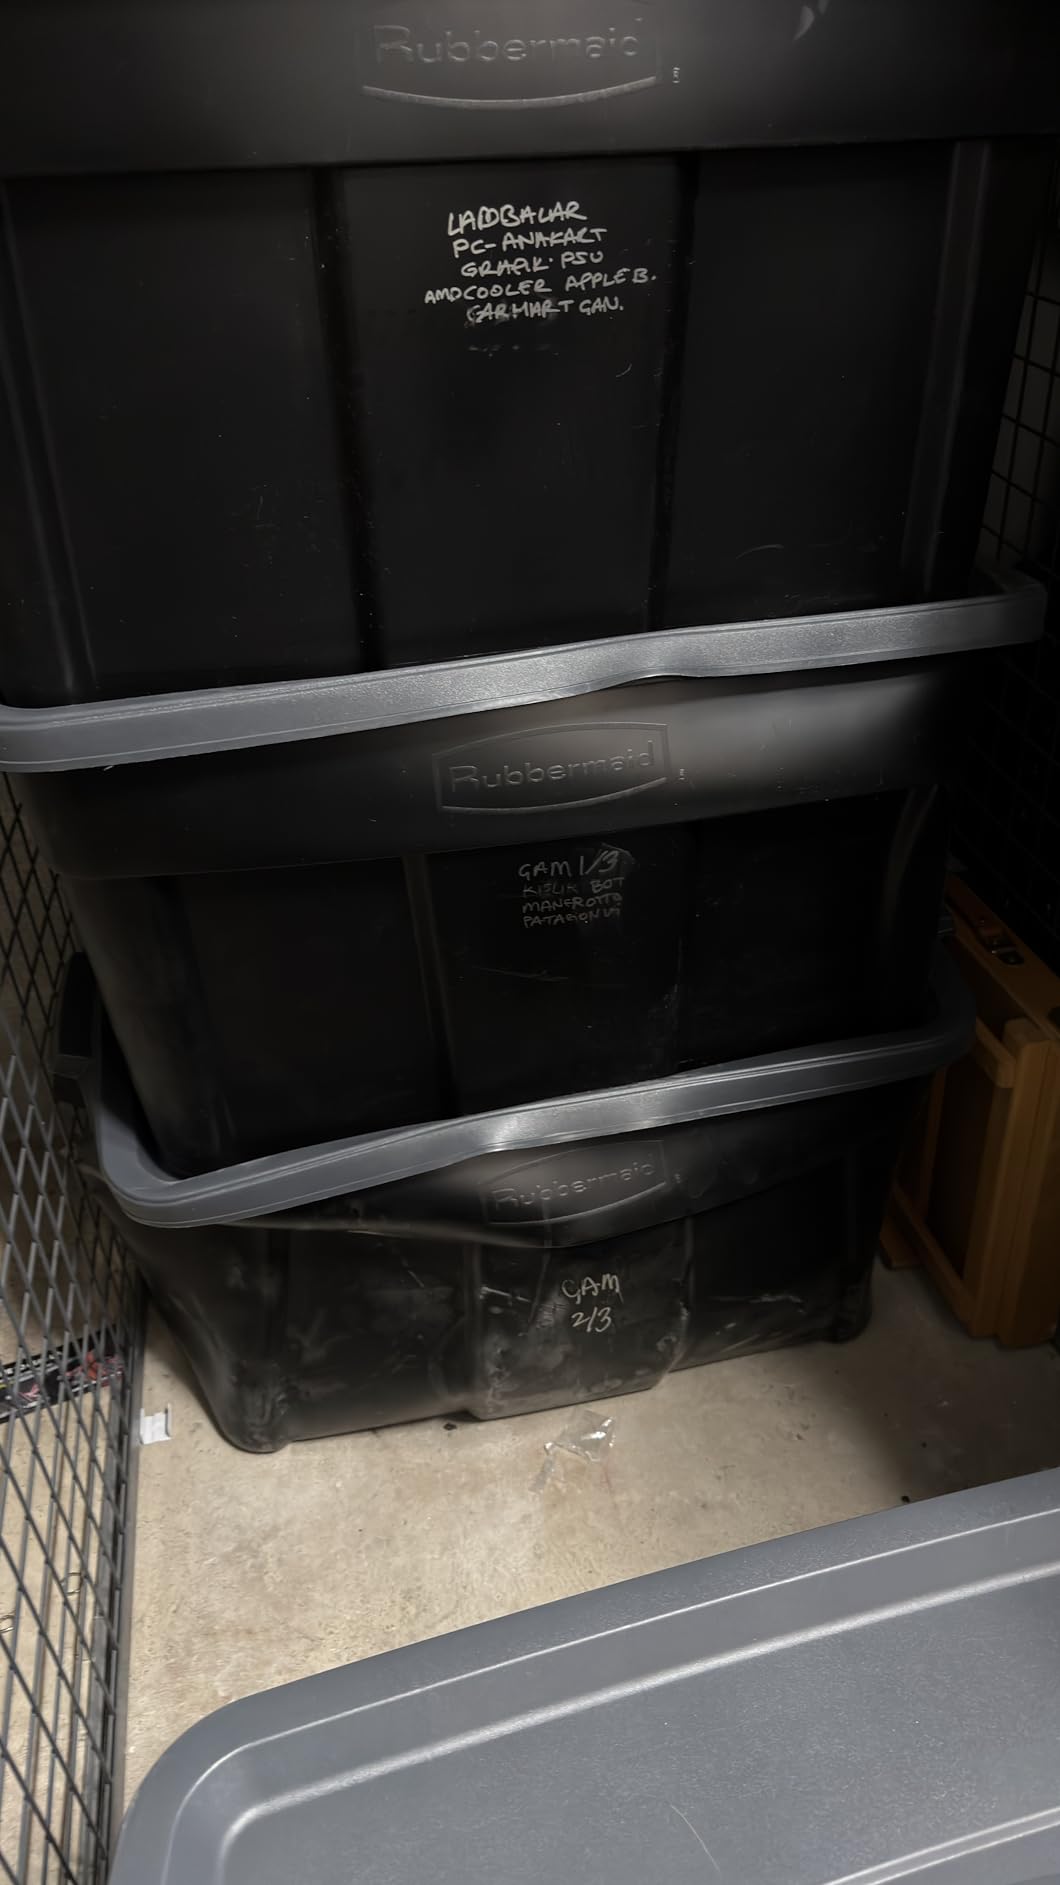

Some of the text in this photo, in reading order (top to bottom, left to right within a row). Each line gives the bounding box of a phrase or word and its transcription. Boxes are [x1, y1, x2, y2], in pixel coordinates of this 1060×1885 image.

[560, 251, 604, 269] PSU
[449, 738, 654, 793] Rubbermaid
[518, 849, 620, 881] GAM 1/3
[561, 1273, 624, 1305] GAM
[571, 1306, 613, 1333] 2/3
